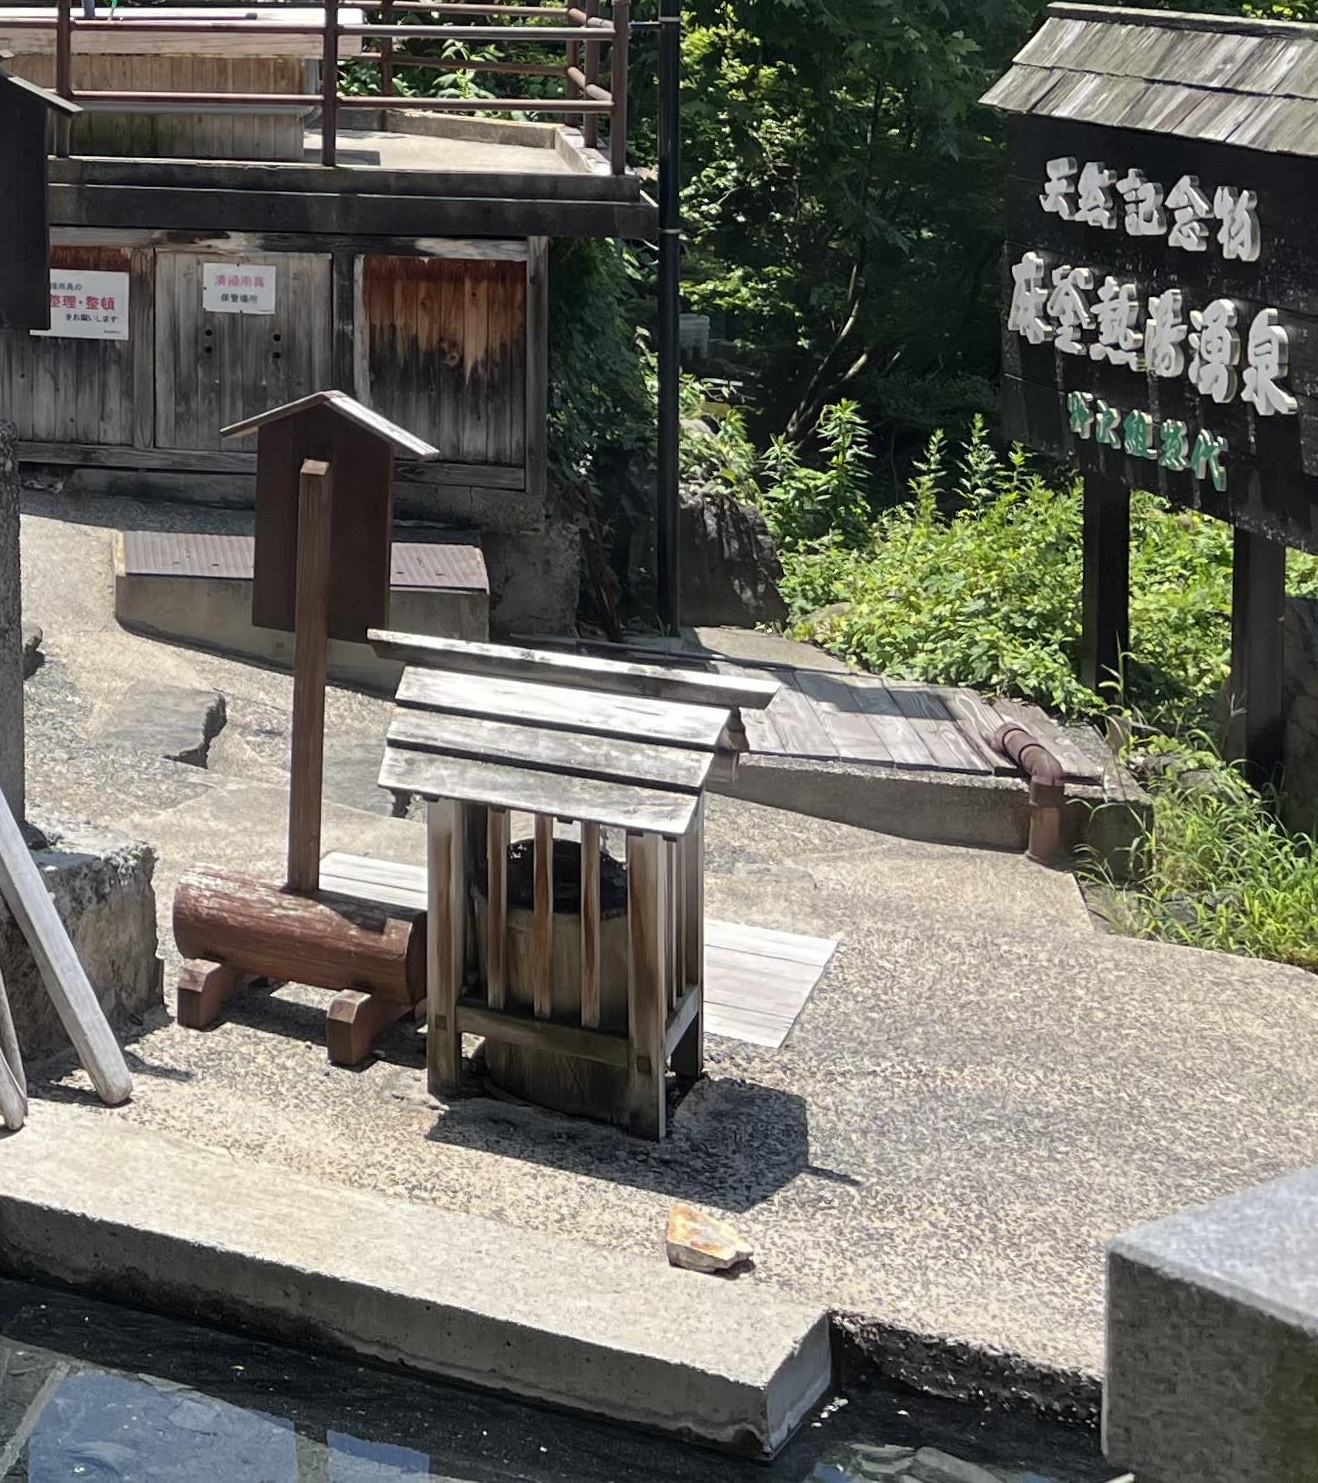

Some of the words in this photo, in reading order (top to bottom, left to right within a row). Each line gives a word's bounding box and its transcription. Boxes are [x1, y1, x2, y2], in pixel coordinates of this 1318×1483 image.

[1038, 156, 1262, 263] 天然記念物
[214, 274, 266, 288] 清掃用具
[50, 294, 116, 311] 整理・整頓
[220, 293, 258, 304] 保管場所
[66, 313, 118, 324] をお願いします
[1007, 250, 1299, 416] 麻釜熱湯湧泉
